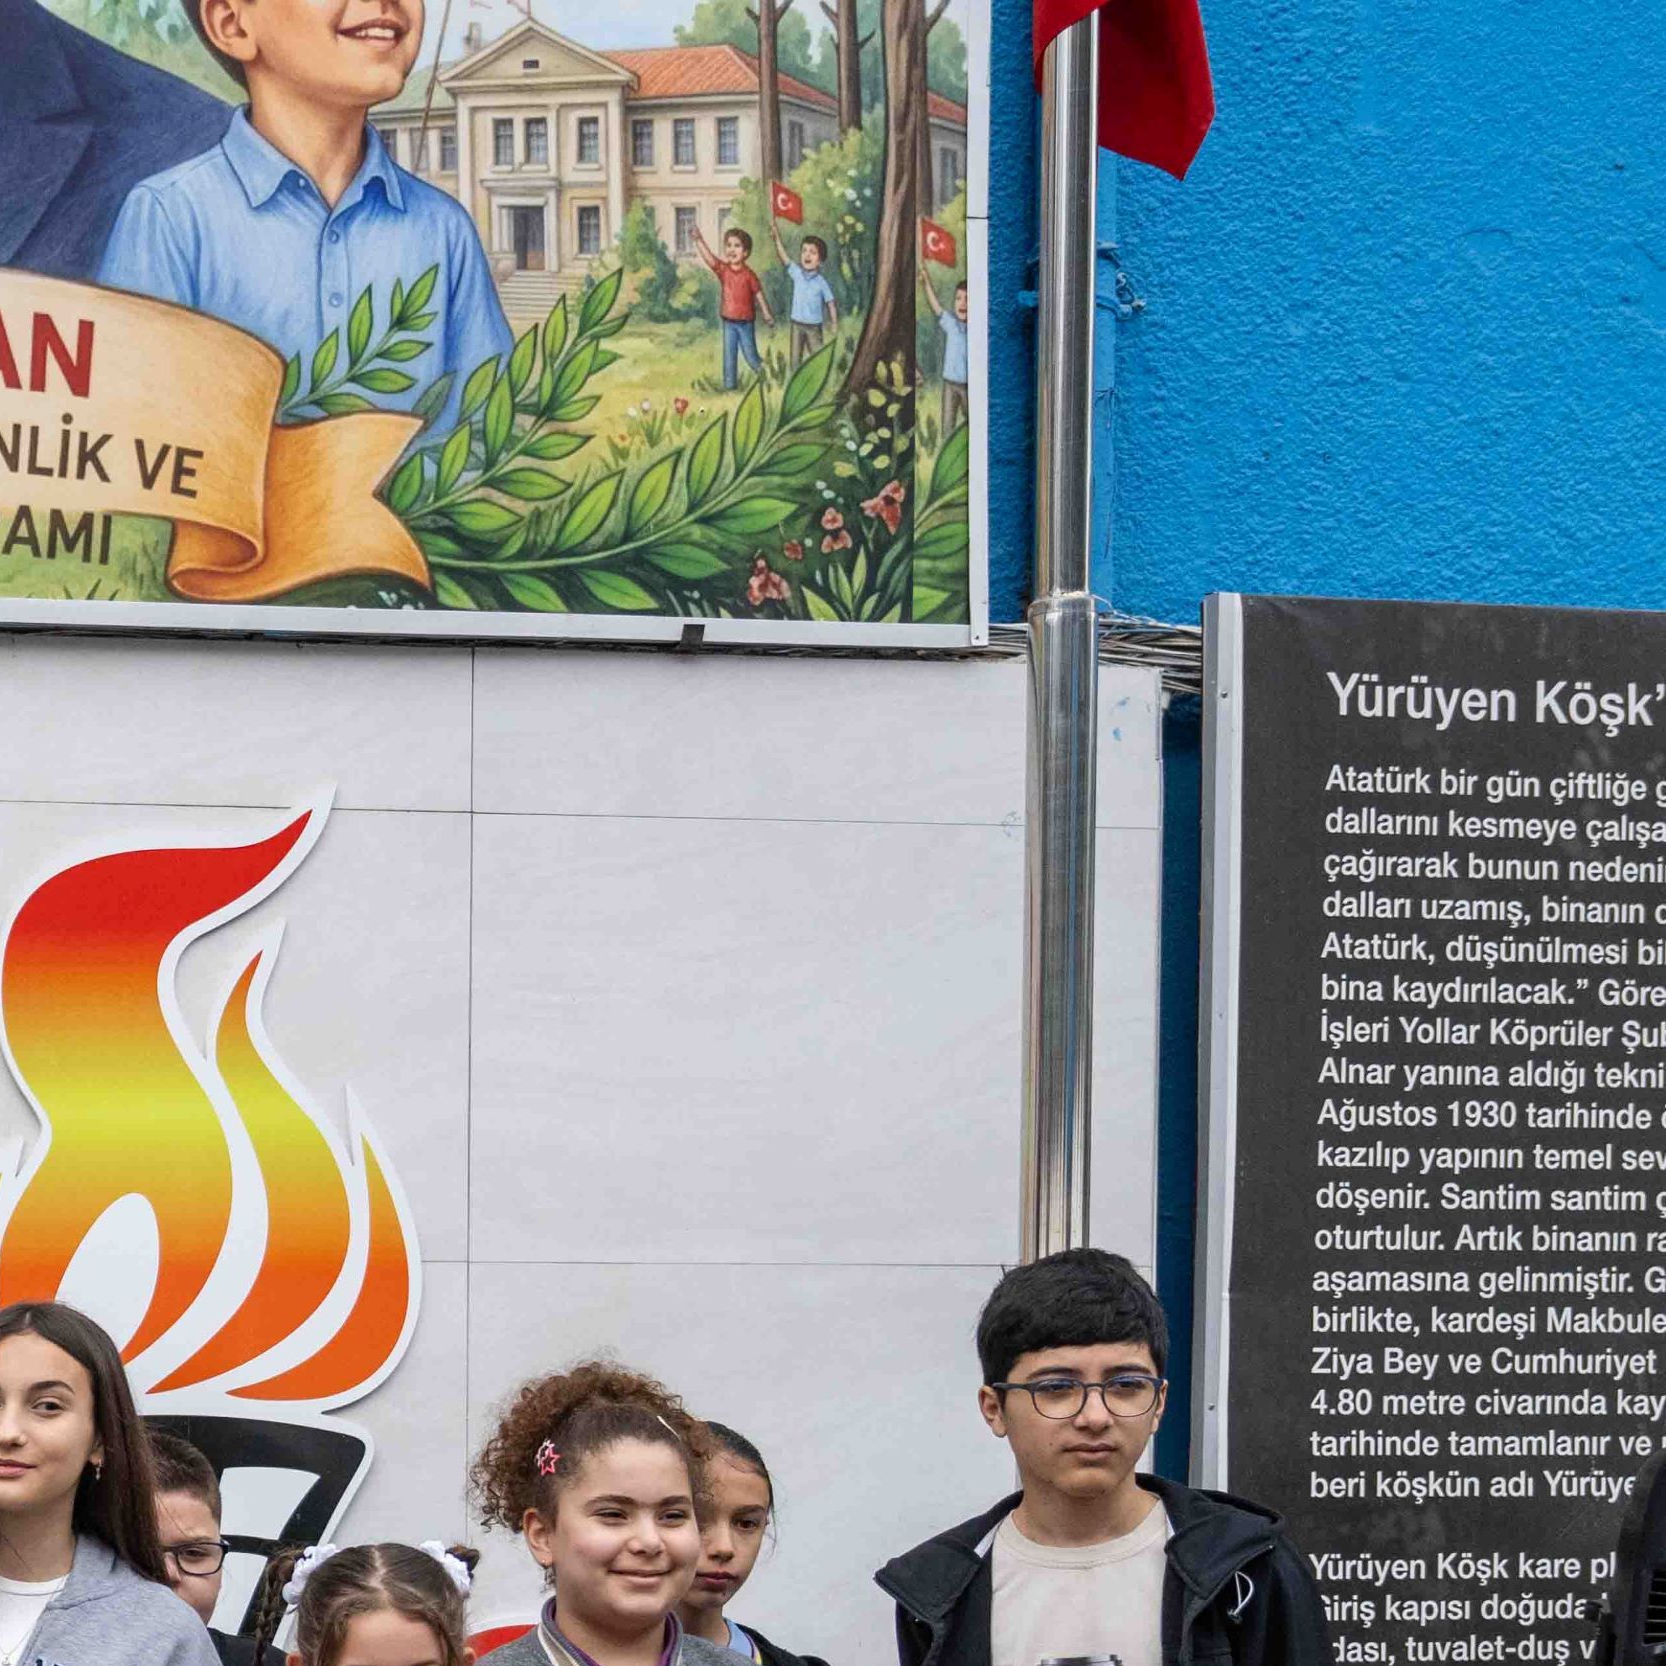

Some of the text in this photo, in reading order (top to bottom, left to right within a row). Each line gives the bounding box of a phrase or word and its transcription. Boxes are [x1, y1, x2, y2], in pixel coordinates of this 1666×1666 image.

[137, 444, 205, 498] VE
[1326, 672, 1516, 730] Yürüyen
[1325, 764, 1431, 793] Atatürk
[1441, 768, 1478, 795] bir
[1486, 770, 1540, 803] gün
[1550, 772, 1647, 806] çiftliğe
[1325, 806, 1438, 836] dallarını
[1449, 810, 1577, 846] kesmeye
[1324, 849, 1666, 883] çağırarak bunun nedeni
[1323, 890, 1411, 918] dalları
[1422, 899, 1531, 928] uzamış,
[1543, 895, 1645, 923] binanın
[1321, 932, 1435, 965] Atatürk,
[1446, 935, 1627, 969] düşünülmesi
[1322, 973, 1384, 1001] bina
[1598, 979, 1666, 1006] Göre
[1321, 1008, 1666, 1054] İşleri Yollar Köprüler Şu
[1318, 1057, 1664, 1094] Alnar yanına aldığı tekni
[1317, 1098, 1437, 1132] Ağustos
[1448, 1100, 1517, 1128] 1930
[1525, 1102, 1652, 1129] tarihinde
[1318, 1140, 1409, 1174] kazılıp
[1419, 1148, 1523, 1174] yapının
[1533, 1144, 1612, 1170] temel
[1316, 1182, 1430, 1216] döşenir.
[1441, 1183, 1540, 1210] Santim
[1551, 1185, 1646, 1210] santim
[1315, 1224, 1444, 1250] oturtulur.
[1454, 1224, 1522, 1251] Artık
[1532, 1225, 1636, 1251] binanın
[1313, 1271, 1470, 1298] aşamasına
[1479, 1266, 1634, 1299] gelinmiştir.
[1313, 1306, 1666, 1340] birlikte, kardeşi Makbule
[1311, 1347, 1657, 1380] Ziya Bey ve Cumhuriyet
[1311, 1389, 1666, 1421] 4.80 metre civarında kay
[1310, 1430, 1439, 1456] tarihinde
[1448, 1430, 1611, 1456] tamamlanır
[1619, 1436, 1652, 1456] ve
[1311, 1471, 1365, 1498] beri
[1377, 1471, 1479, 1504] köşkün
[1490, 1470, 1533, 1497] adı
[1309, 1553, 1425, 1586] Yürüyen
[1438, 1552, 1509, 1586] Köşk
[1519, 1552, 1581, 1578] kare
[1386, 1595, 1470, 1626] kapısı
[1405, 1634, 1570, 1666] tuvalet-duş
